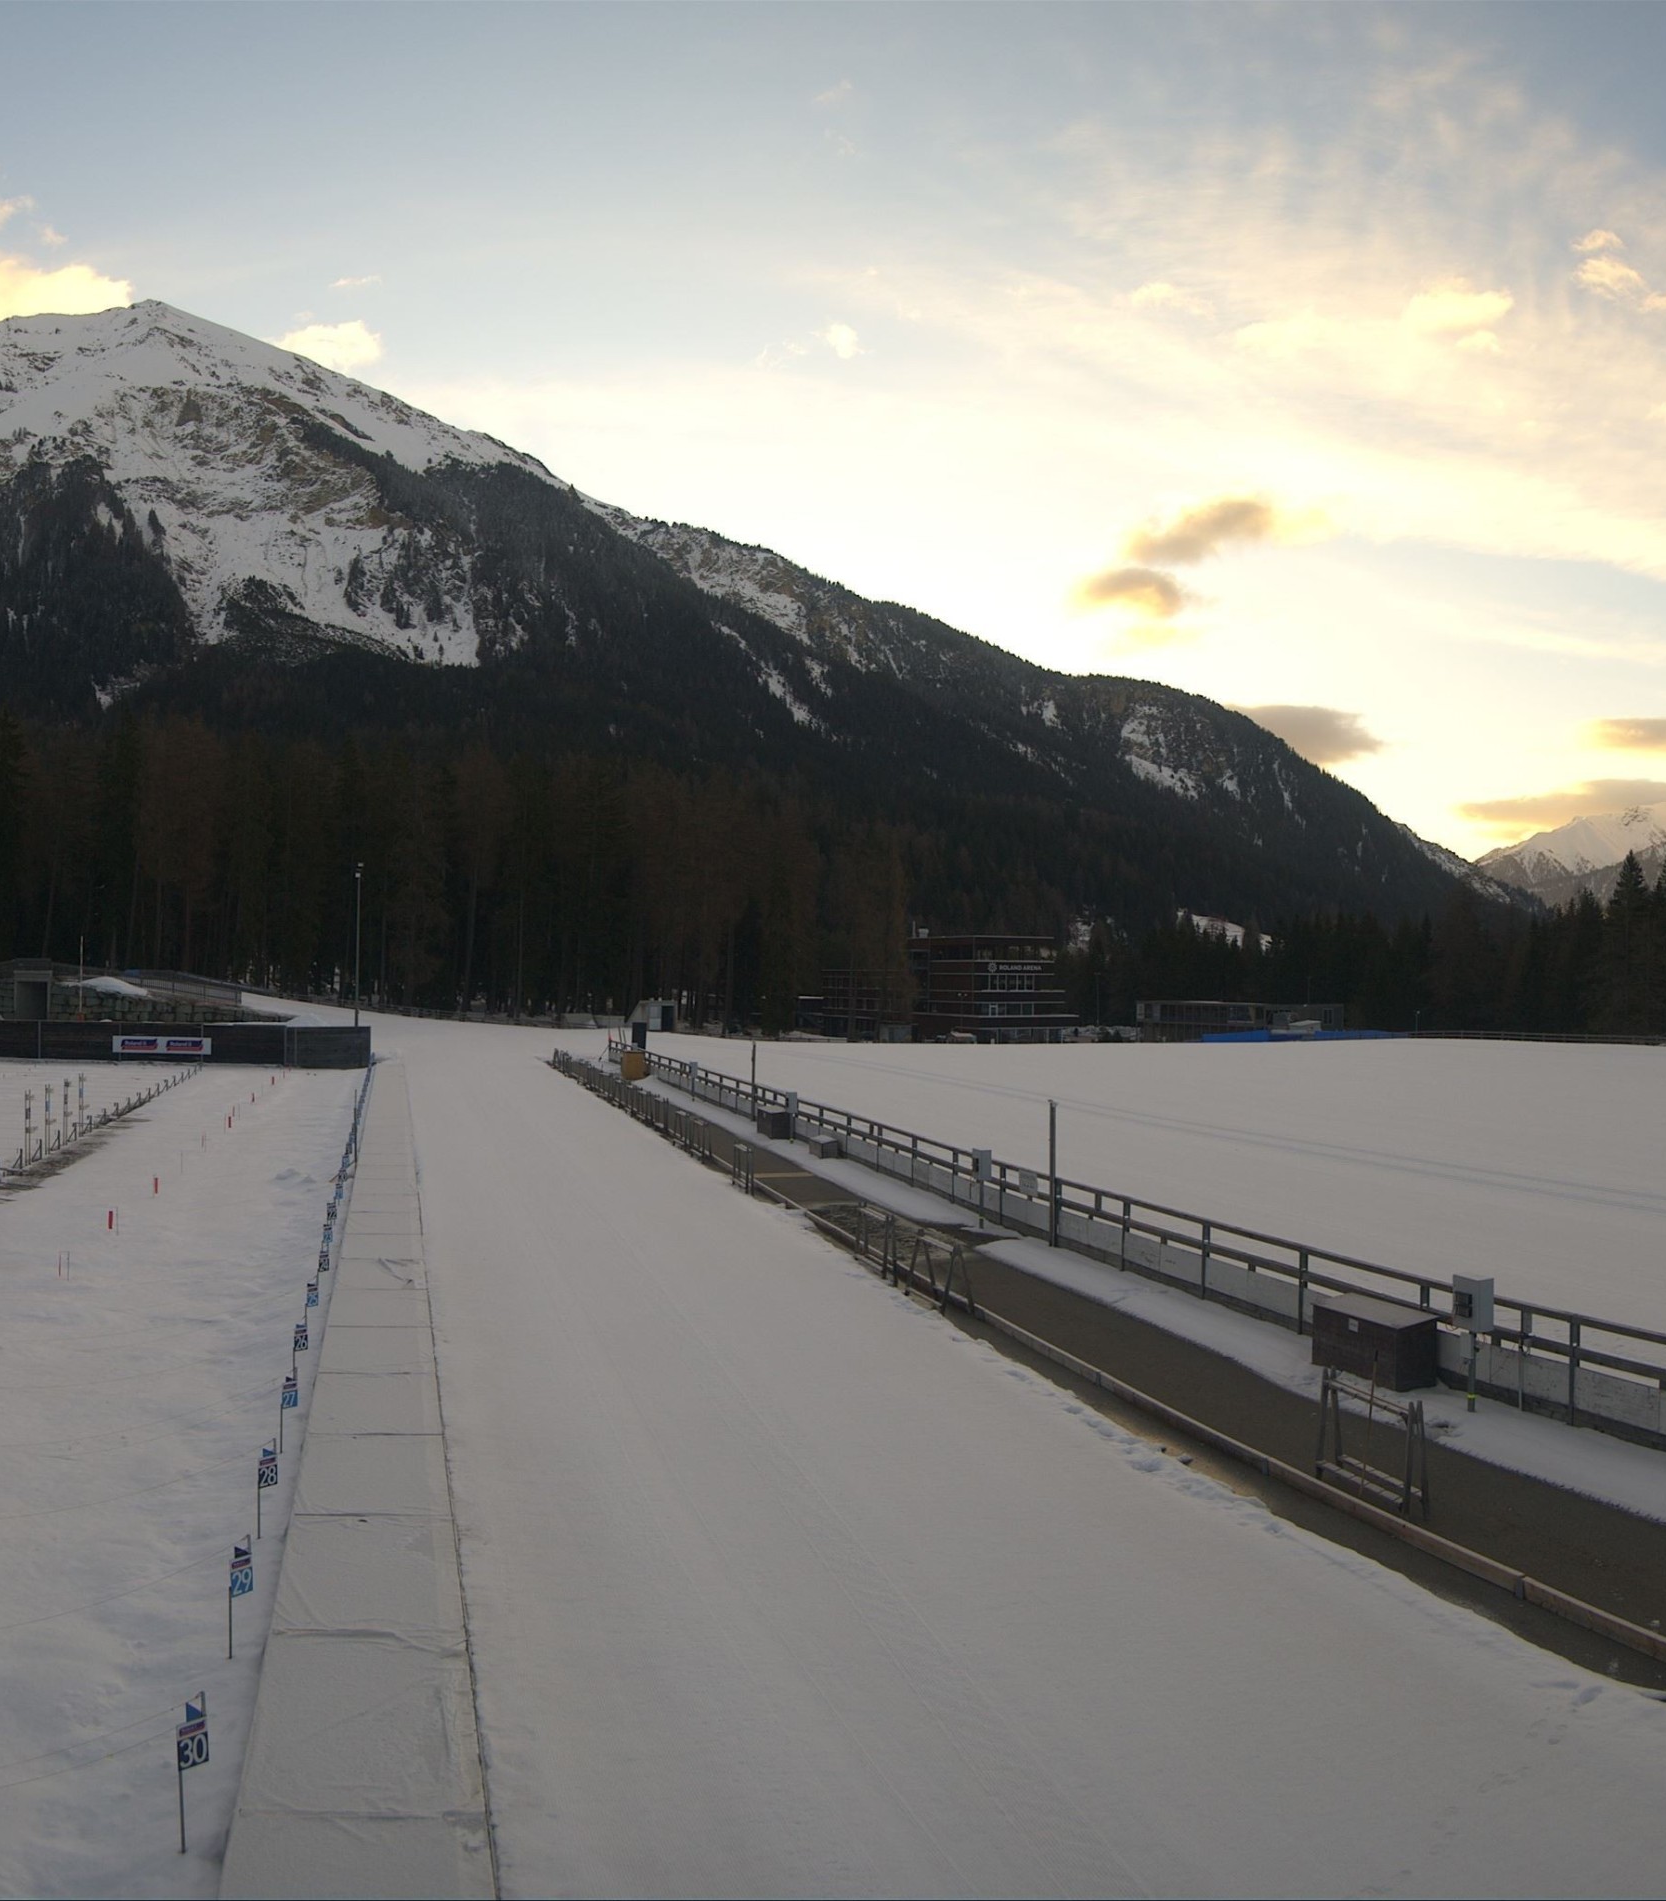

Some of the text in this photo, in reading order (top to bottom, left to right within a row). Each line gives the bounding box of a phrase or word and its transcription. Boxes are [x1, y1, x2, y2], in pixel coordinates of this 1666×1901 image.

[295, 1335, 308, 1350] 26
[283, 1392, 297, 1407] 27
[260, 1464, 277, 1487] 28
[231, 1568, 252, 1595] 29
[178, 1733, 208, 1770] 30
